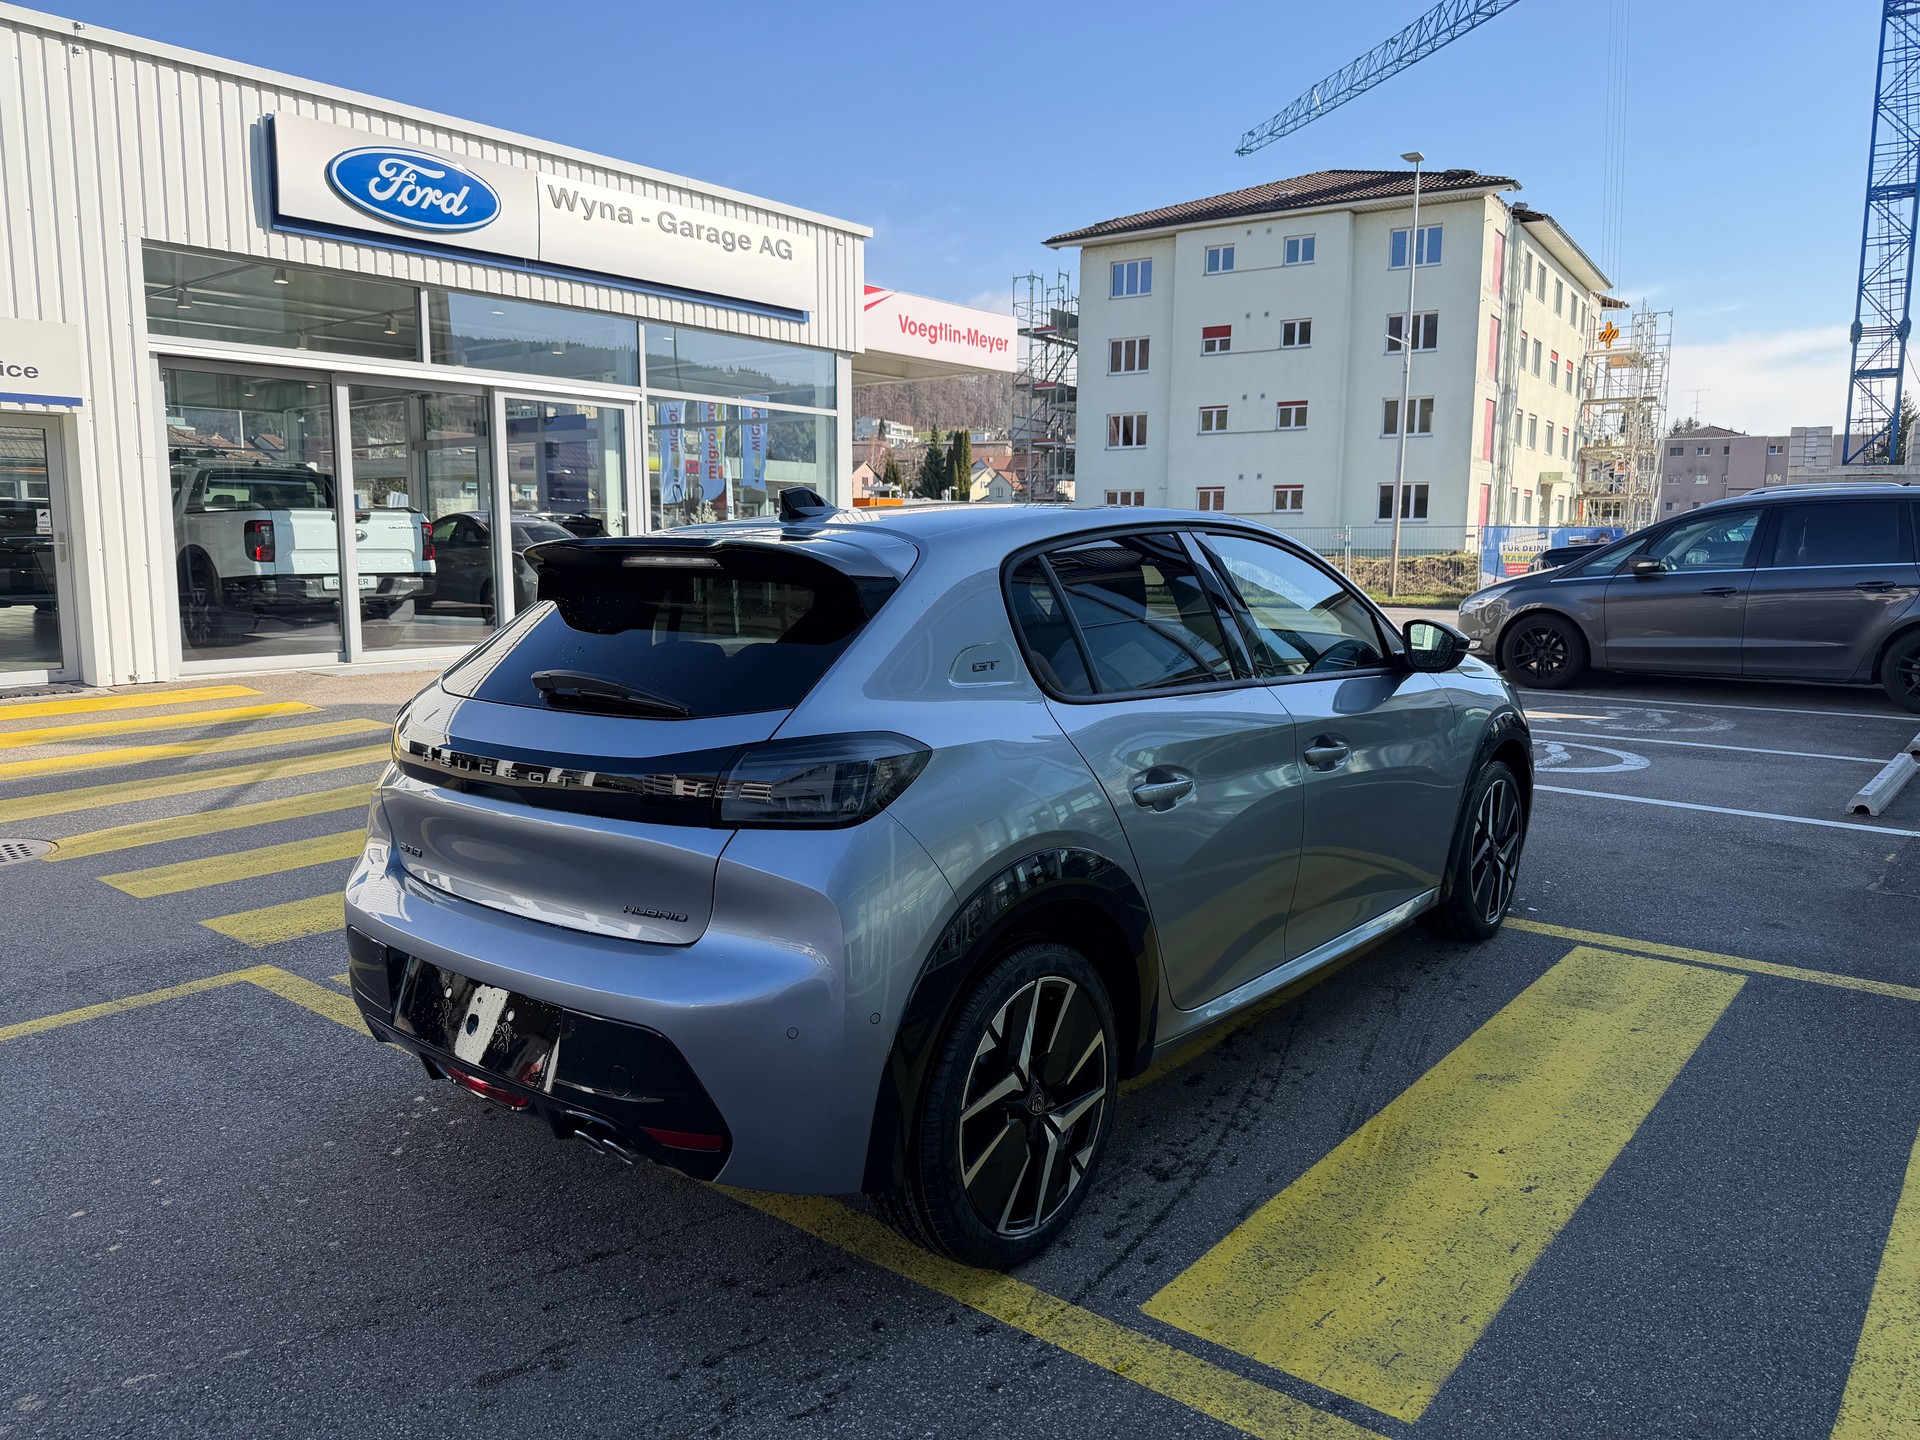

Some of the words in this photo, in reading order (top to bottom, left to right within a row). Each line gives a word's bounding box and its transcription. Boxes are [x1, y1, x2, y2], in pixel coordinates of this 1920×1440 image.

[367, 156, 471, 219] Ford
[546, 183, 634, 227] Wyna
[657, 210, 753, 254] Garage
[757, 230, 794, 263] AG
[898, 313, 1009, 354] Voegtlin-Meyer
[669, 407, 680, 453] MIGOL
[705, 403, 720, 480] migrolno
[1503, 543, 1520, 552] FÜR
[972, 660, 1000, 673] GT
[422, 752, 573, 788] PEUGEOT
[623, 905, 689, 923] HYBRID
